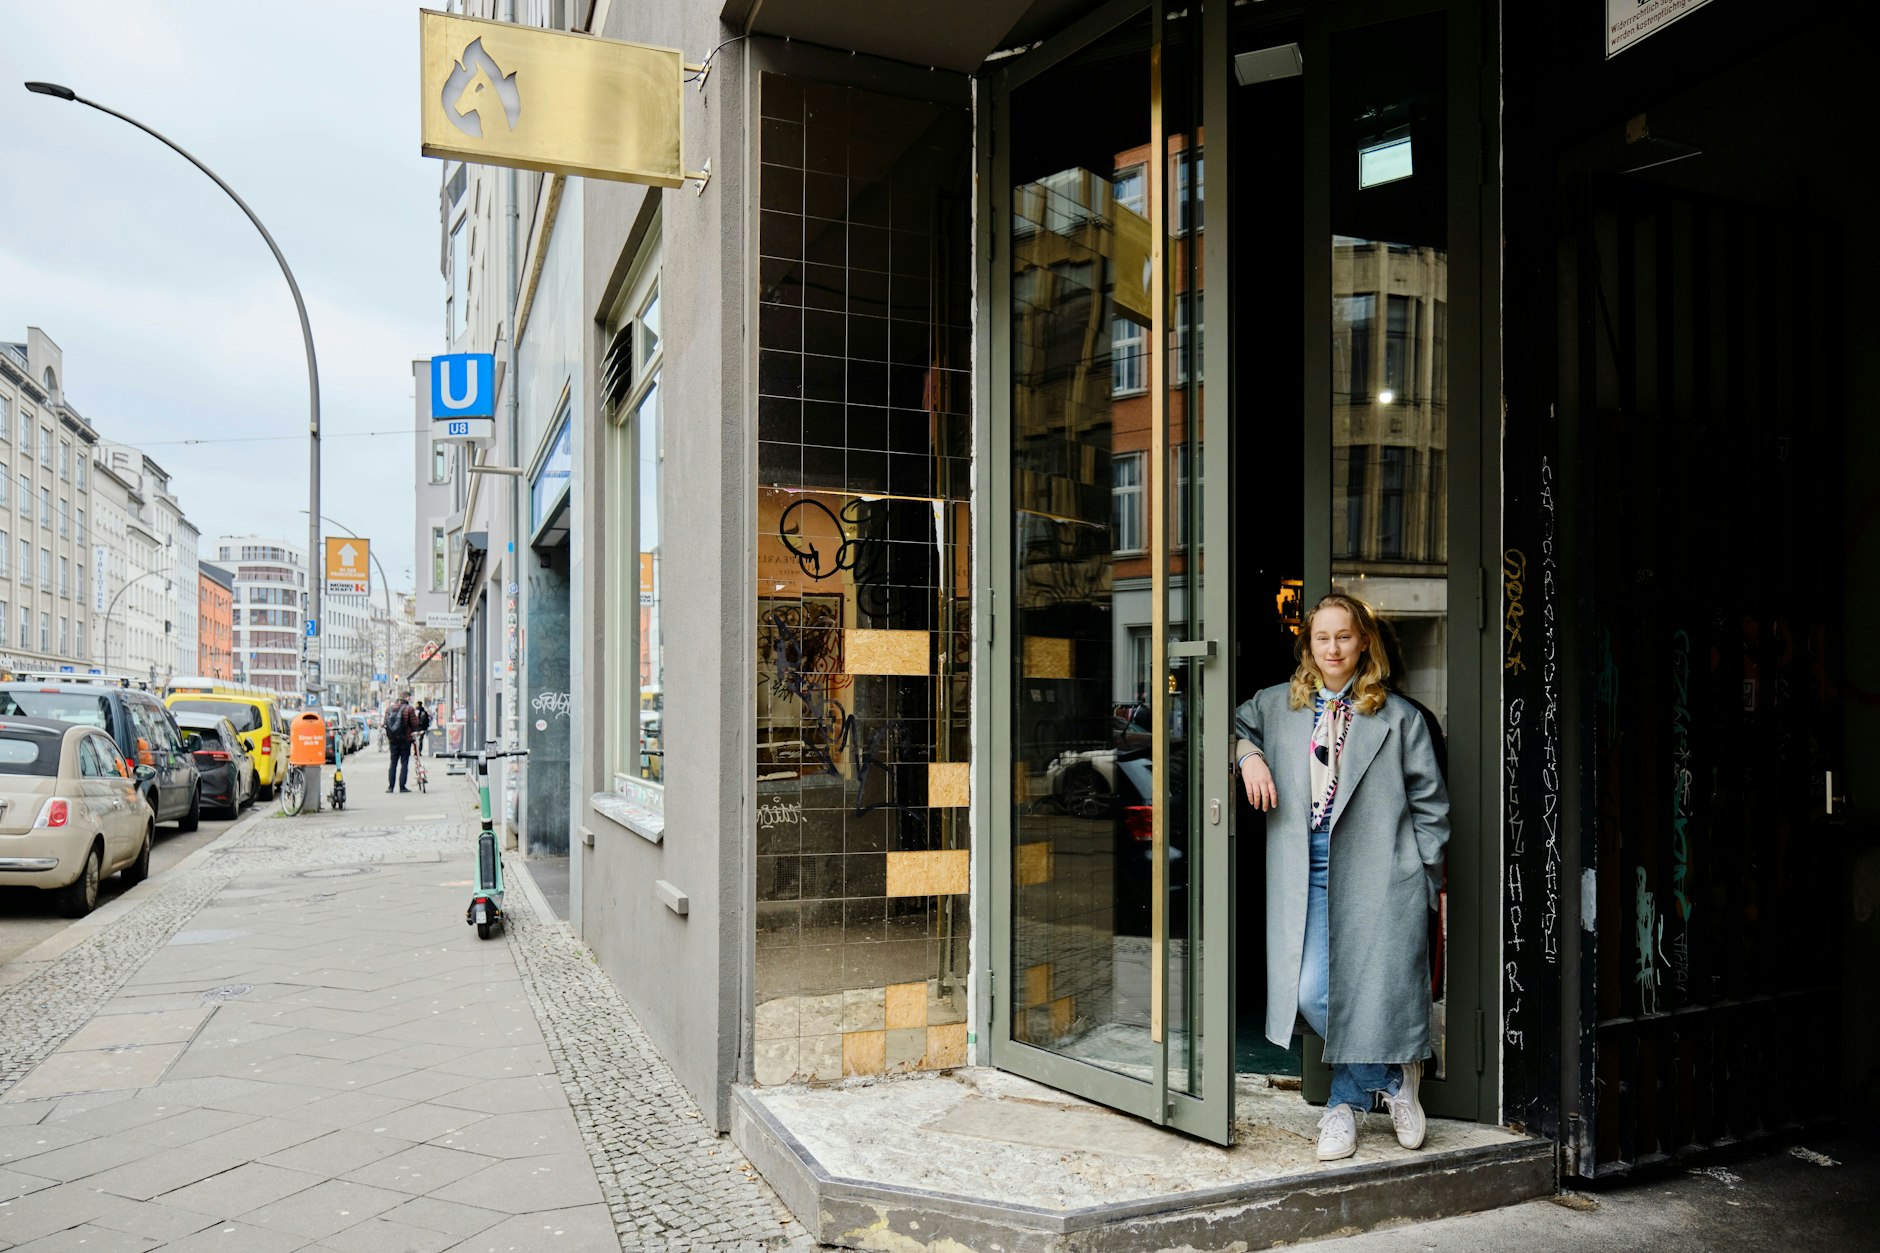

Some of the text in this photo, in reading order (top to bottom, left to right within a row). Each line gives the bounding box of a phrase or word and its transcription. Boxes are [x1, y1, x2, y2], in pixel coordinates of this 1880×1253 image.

[1610, 0, 1659, 34] Widerrechtlich
[1611, 1, 1686, 46] werden kostenpflichtig
[440, 359, 478, 410] U
[450, 423, 467, 434] U8
